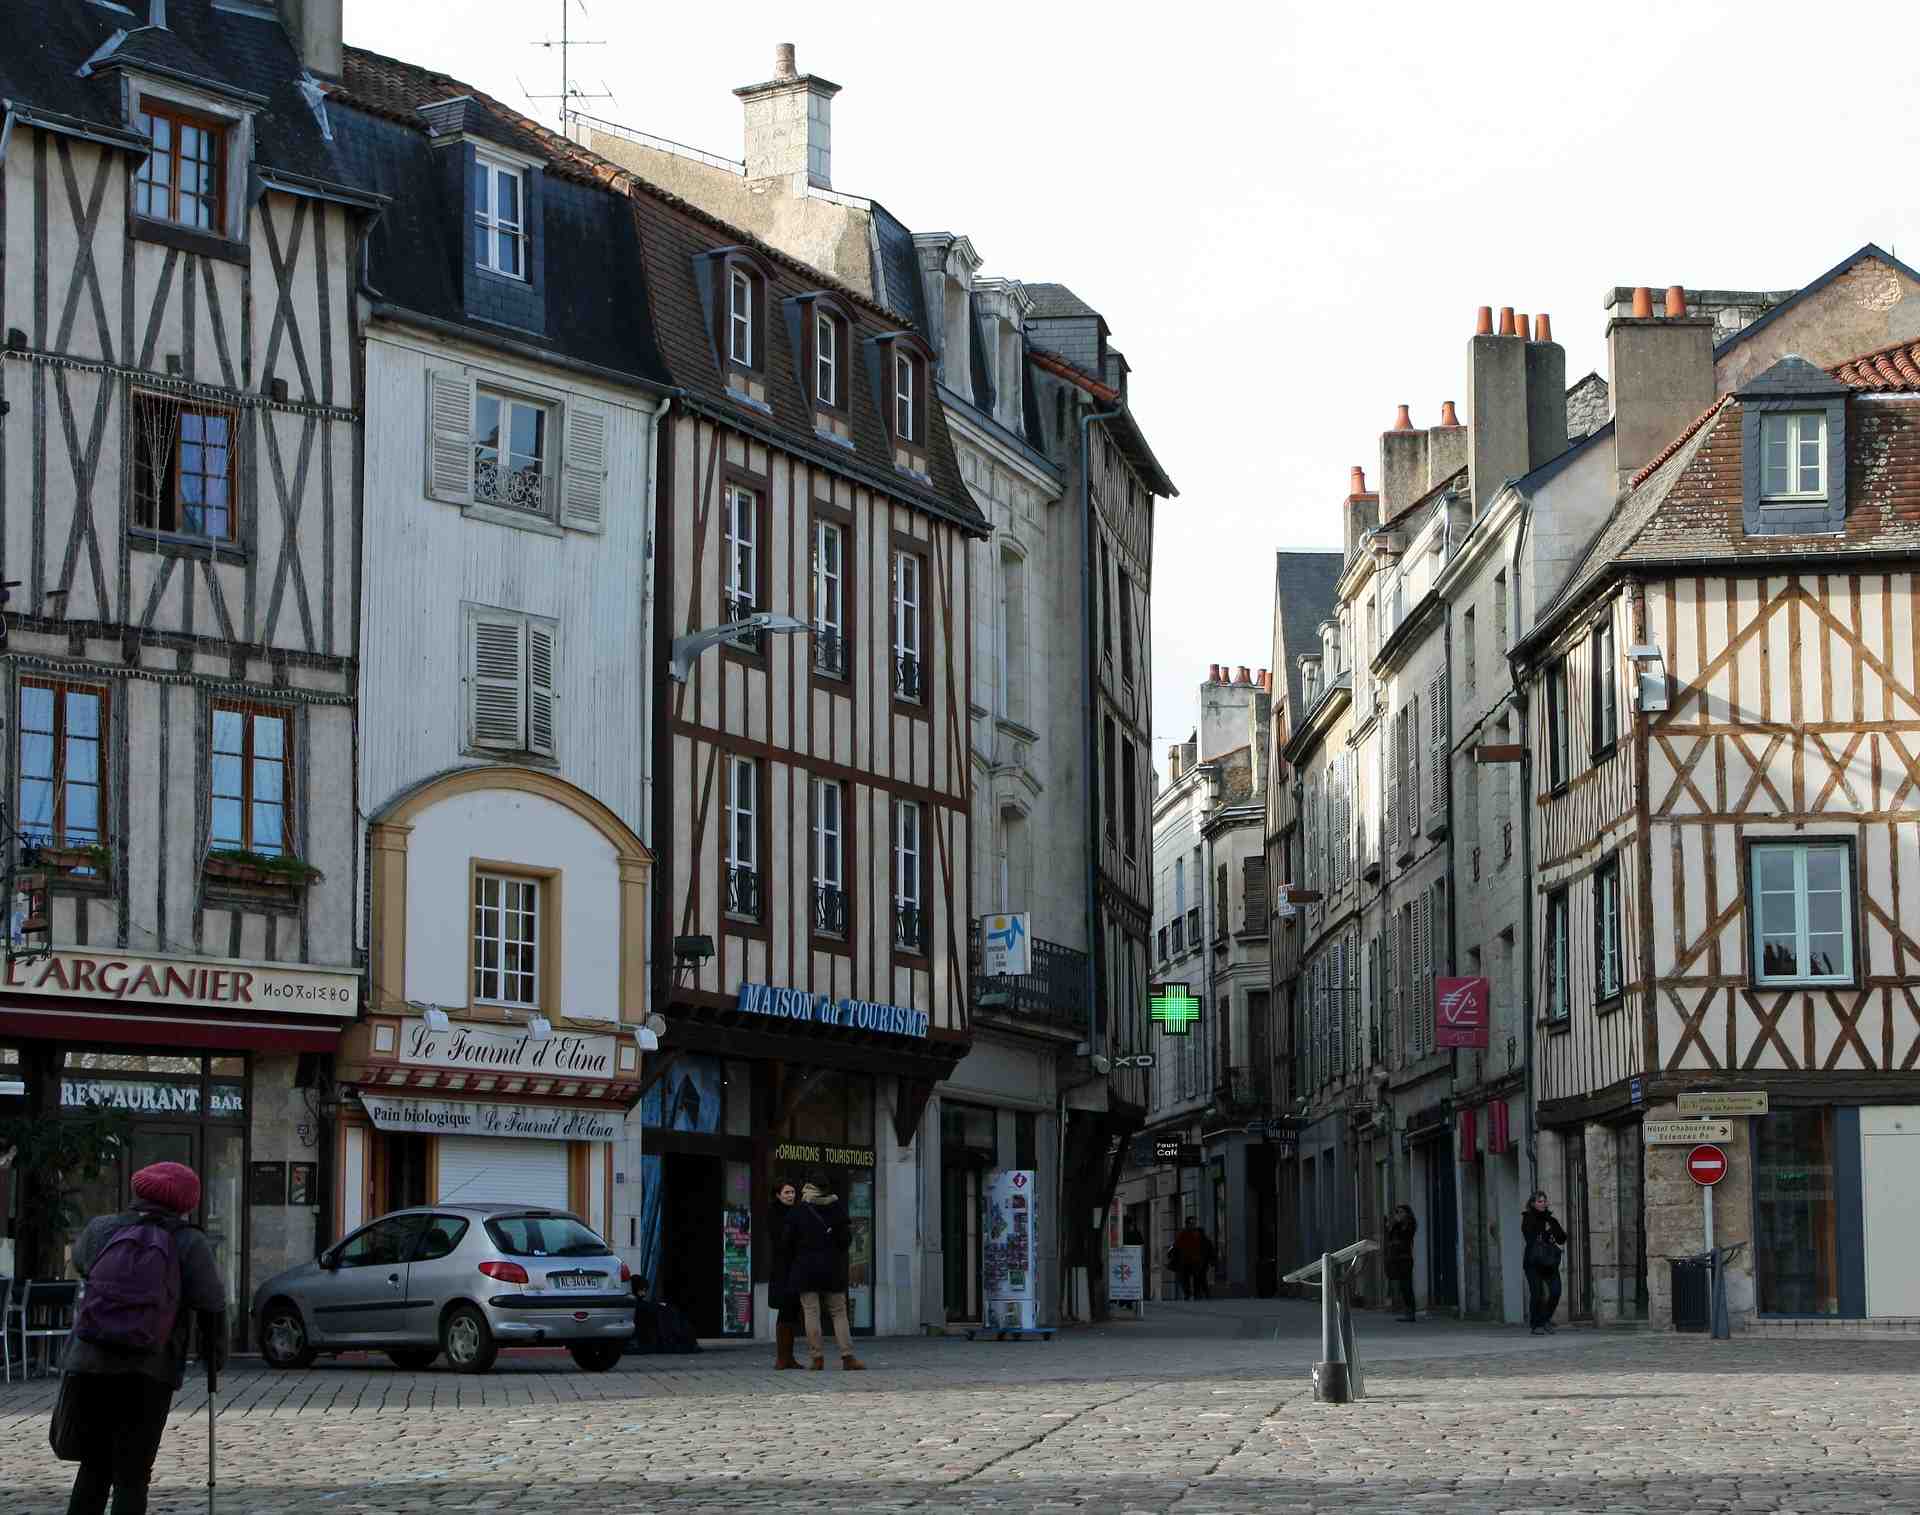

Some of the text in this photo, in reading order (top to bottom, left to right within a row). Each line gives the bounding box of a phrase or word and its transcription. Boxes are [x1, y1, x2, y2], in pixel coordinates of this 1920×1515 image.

[745, 985, 929, 1038] MAISON du TOURISME
[408, 1024, 436, 1059] Le
[448, 1027, 529, 1066] Fournil
[60, 1082, 243, 1111] RESTAURANT BAR
[373, 1106, 471, 1126] Pain biologique
[485, 1111, 502, 1131] Le
[504, 1111, 561, 1134] Fournil
[824, 1147, 875, 1167] TOURISTIQUES
